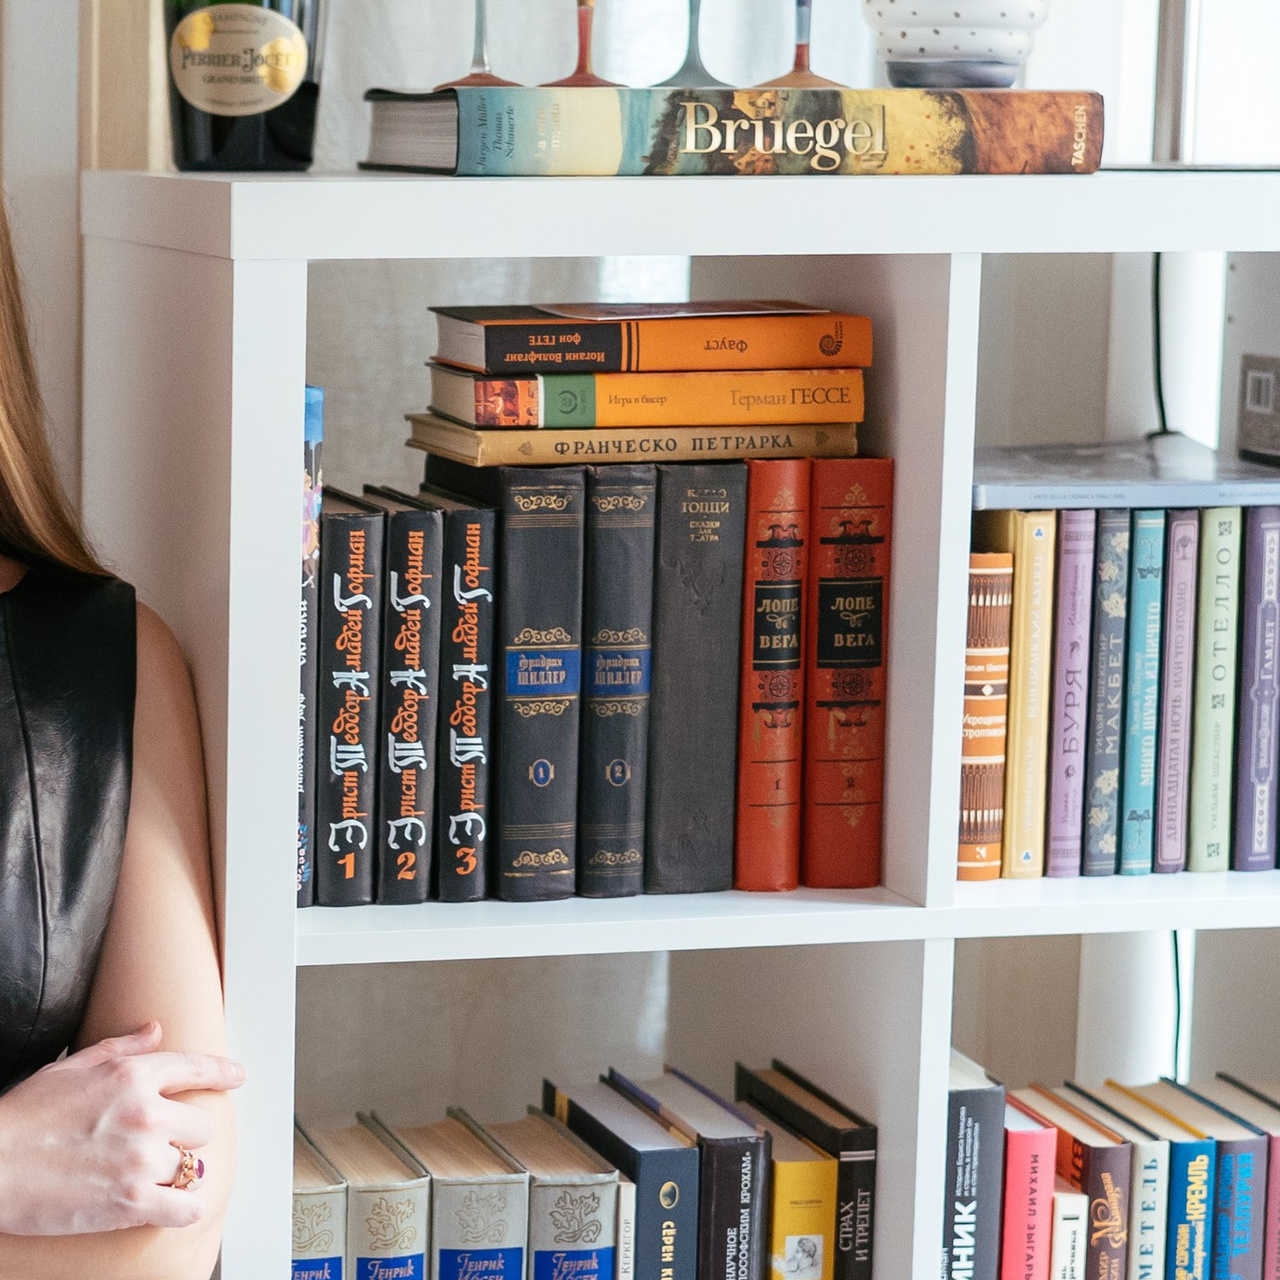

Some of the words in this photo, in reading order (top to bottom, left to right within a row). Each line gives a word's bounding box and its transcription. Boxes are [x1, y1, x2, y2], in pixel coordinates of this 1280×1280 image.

[492, 112, 503, 151] Thomas
[680, 101, 887, 172] Bruegel
[1071, 105, 1087, 167] TASCHEN
[503, 350, 563, 365] Вольфганг
[529, 335, 553, 345] ГЕТЕ
[555, 332, 581, 345] фон
[565, 350, 606, 363] Иоганн
[705, 338, 748, 354] Фауст
[608, 393, 631, 406] Игра
[642, 393, 666, 407] бисер
[729, 389, 786, 409] Герман
[790, 387, 851, 406] ГЕССЕ
[555, 437, 677, 456] ФРАНЧЕСКО
[692, 433, 792, 452] ПЕТРАРКА
[334, 530, 374, 612] Гофман
[390, 530, 433, 612] Гофман
[453, 523, 493, 605] Гофман
[757, 597, 799, 613] ЛОПЕ
[830, 596, 874, 611] ЛОПЕ
[1144, 602, 1160, 657] НИЧЕГО
[1211, 548, 1232, 681] ОТЕЛЛО
[333, 609, 370, 697] Амадей
[390, 609, 427, 694] Амадей
[452, 602, 487, 689] Амадей
[759, 634, 799, 649] ВЕГА
[833, 633, 874, 648] ВЕГА
[517, 669, 567, 687] ШИЛЛЕР
[595, 669, 643, 687] ШИЛЛЕР
[1105, 633, 1122, 754] МАКБЕТ
[1144, 658, 1157, 679] ИЗ
[330, 690, 371, 774] Теодор
[388, 690, 430, 773] Теодор
[450, 683, 490, 767] Теодор
[1061, 668, 1082, 755] БУРЯ
[1142, 685, 1157, 729] ШУМА
[1141, 733, 1155, 786] МНОГО
[329, 771, 367, 852] Эрнст
[387, 769, 425, 849] Эрнст
[449, 764, 486, 844] Эрнст
[1166, 738, 1181, 840] ДВЕНАДЦАТАЯ
[337, 852, 356, 879] 1
[397, 852, 417, 880] 2
[456, 847, 476, 874] 3
[1028, 1154, 1039, 1217] МИХАИЛ
[1186, 1155, 1209, 1220] КРЕМЛЬ
[1219, 1154, 1233, 1209] СОРОКИН
[1232, 1153, 1254, 1257] ТЕЛЛУРИЯ
[661, 1220, 677, 1261] СЁРЕН
[839, 1201, 854, 1252] СТРАХ
[855, 1189, 871, 1245] ТРЕПЕТ
[1137, 1158, 1157, 1280] МЕТЕЛЬ
[621, 1219, 632, 1274] КЕРКЕГОР
[855, 1249, 868, 1261] И
[1176, 1224, 1190, 1266] СОРОКИН
[1215, 1212, 1231, 1278] ВЛАДИМИР
